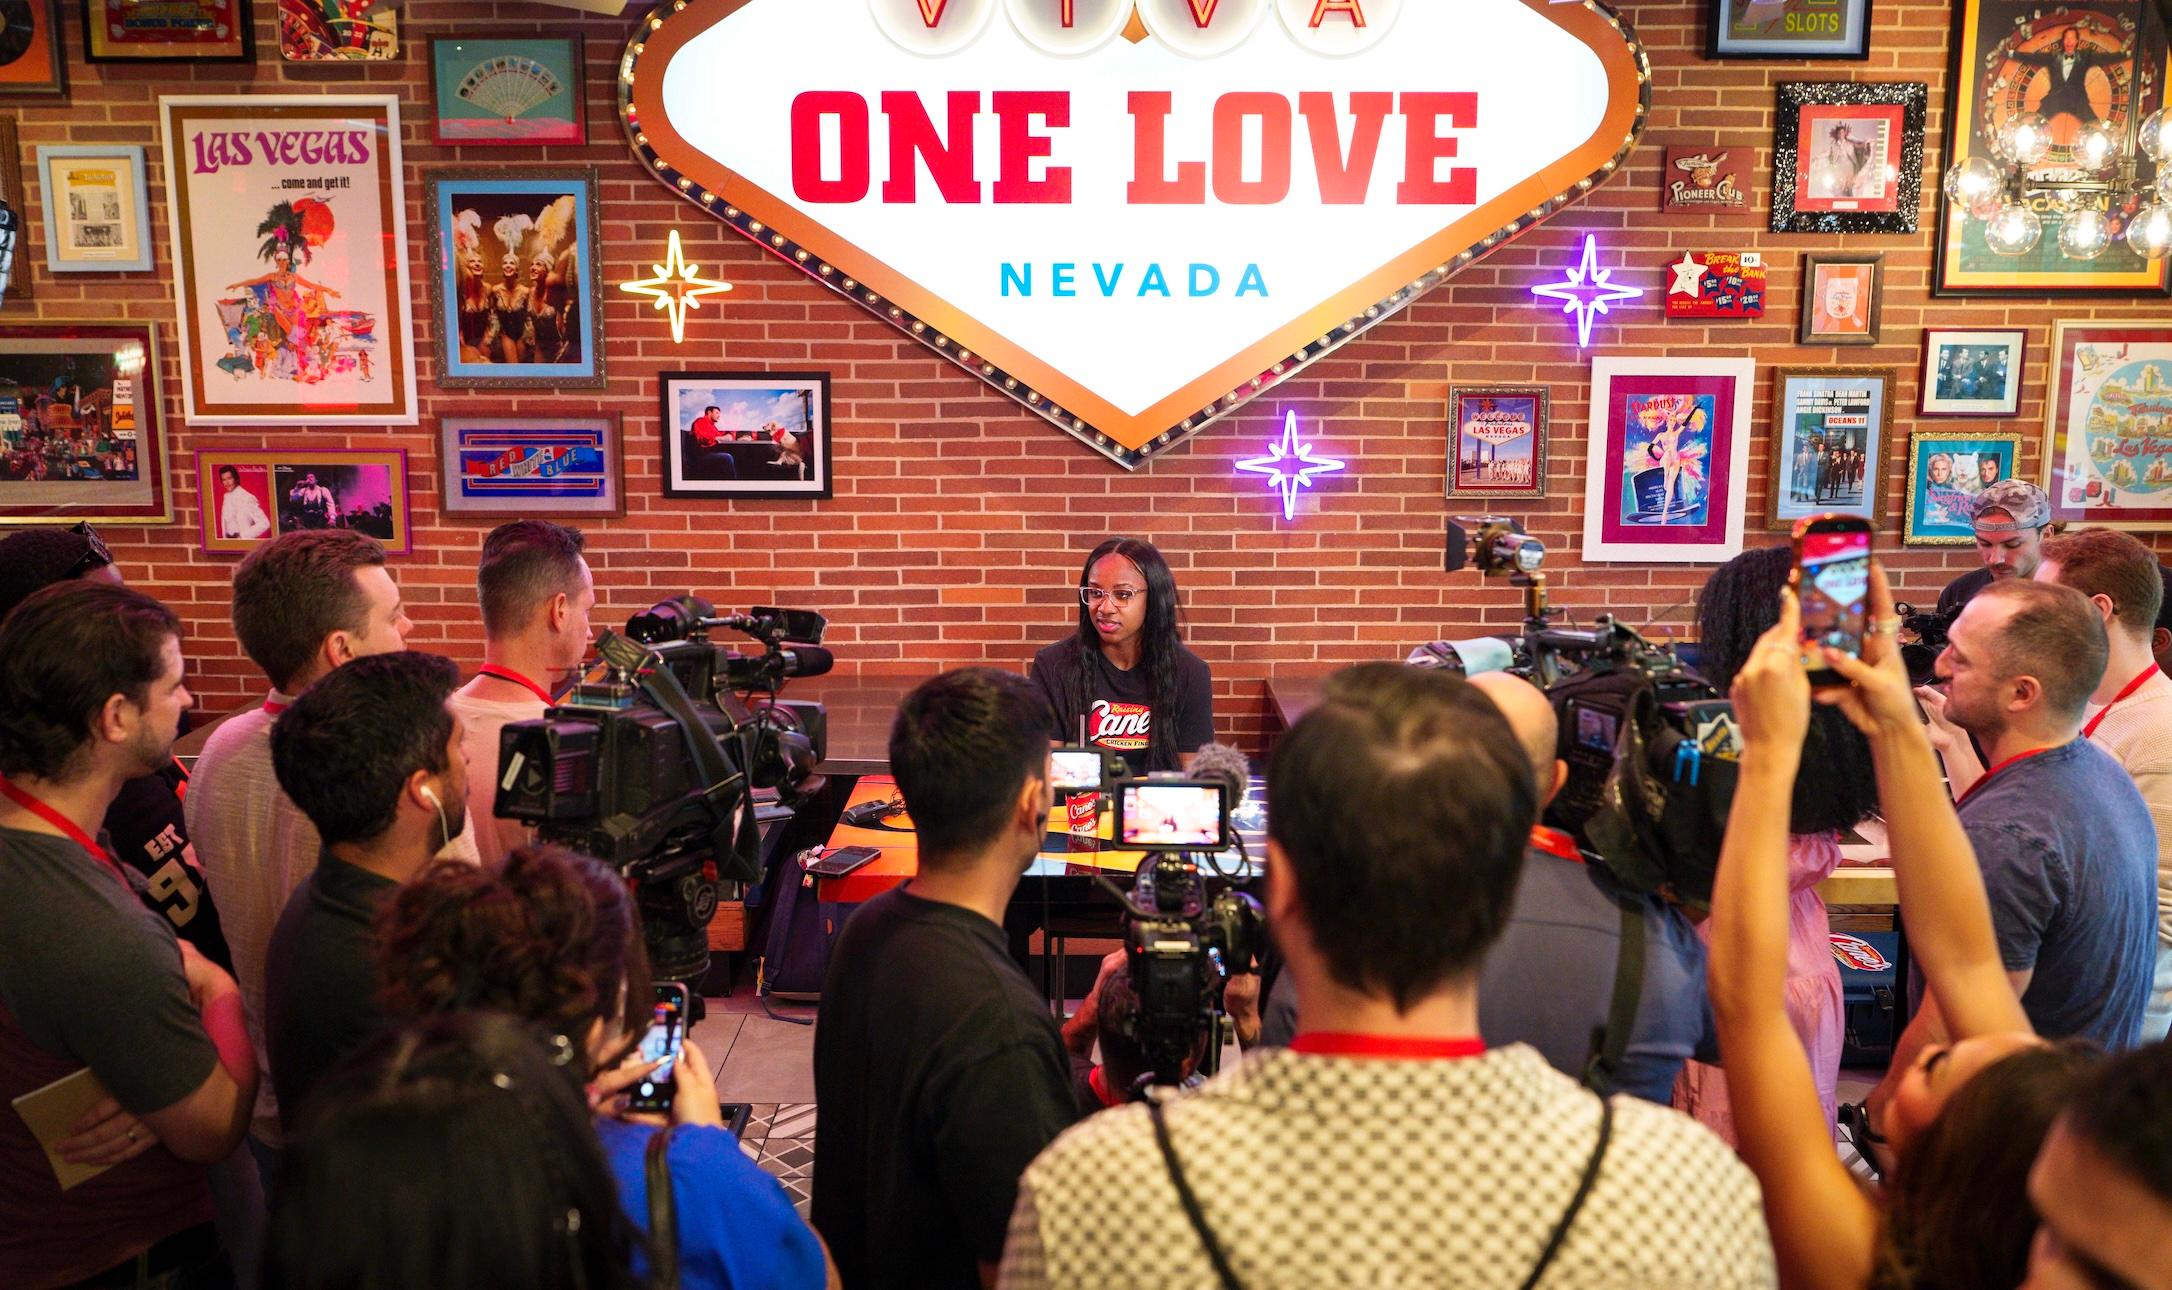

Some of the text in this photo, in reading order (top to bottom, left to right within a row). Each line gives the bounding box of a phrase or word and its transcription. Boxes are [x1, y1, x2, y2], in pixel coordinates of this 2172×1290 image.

[1785, 12, 1839, 32] SLOTS
[192, 131, 370, 174] LAS VEGAS
[791, 91, 1480, 204] ONE LOVE
[281, 178, 306, 189] come
[306, 177, 323, 189] and
[323, 178, 340, 191] get
[340, 176, 350, 189] it!
[1671, 180, 1744, 202] PIONEER CLUB
[1704, 253, 1740, 265] BREAK
[1000, 262, 1270, 297] NEVADA
[1723, 263, 1767, 279] the BANK
[1473, 426, 1525, 435] LAS VEGAS
[489, 450, 517, 476] RED
[546, 449, 577, 476] BLUE
[1110, 703, 1145, 716] Raising
[1106, 739, 1133, 747] CHICKEN
[144, 823, 184, 862] EST
